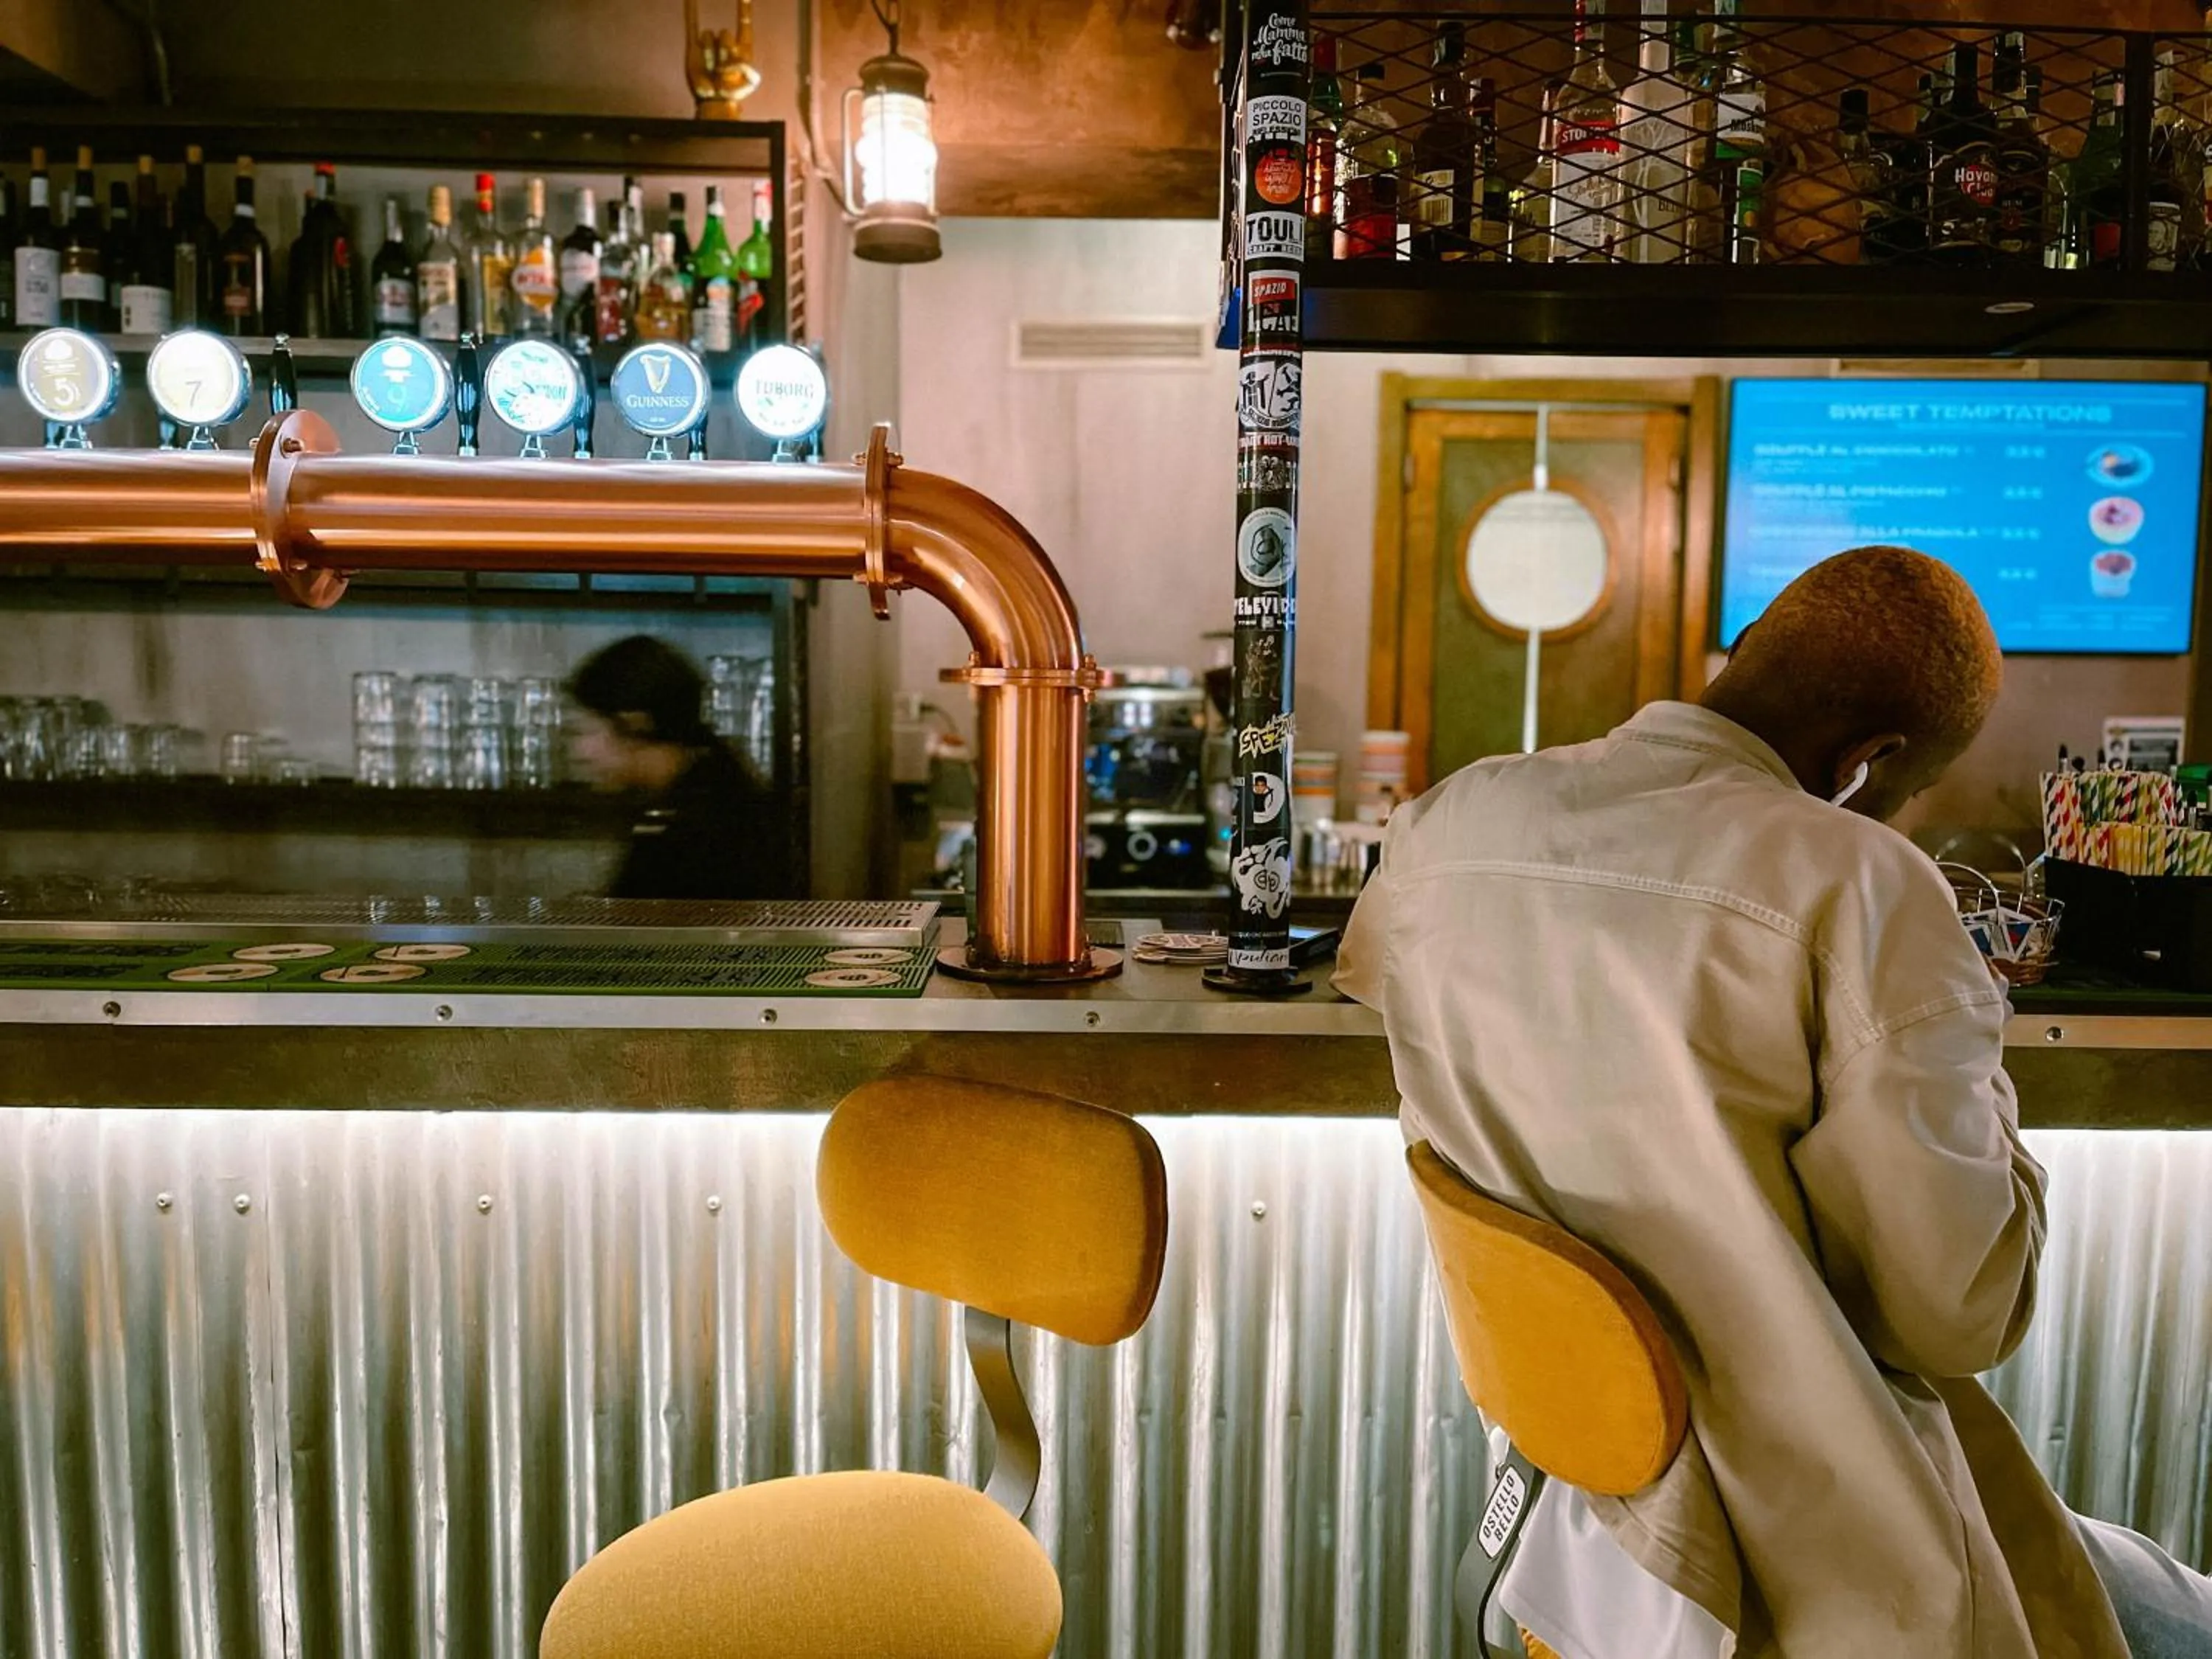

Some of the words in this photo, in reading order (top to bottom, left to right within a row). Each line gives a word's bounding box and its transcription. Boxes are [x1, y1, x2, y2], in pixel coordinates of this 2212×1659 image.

[1268, 13, 1296, 29] Come
[1253, 100, 1301, 113] PICCOLO
[1253, 111, 1301, 127] SPAZIO
[1254, 282, 1287, 298] SPAZIO
[186, 380, 203, 407] 7
[626, 394, 689, 408] GUINNESS
[1927, 404, 2112, 423] TEMPTATIONS
[1483, 1475, 1514, 1538] OSTELLO
[1494, 1495, 1519, 1542] BELLO
